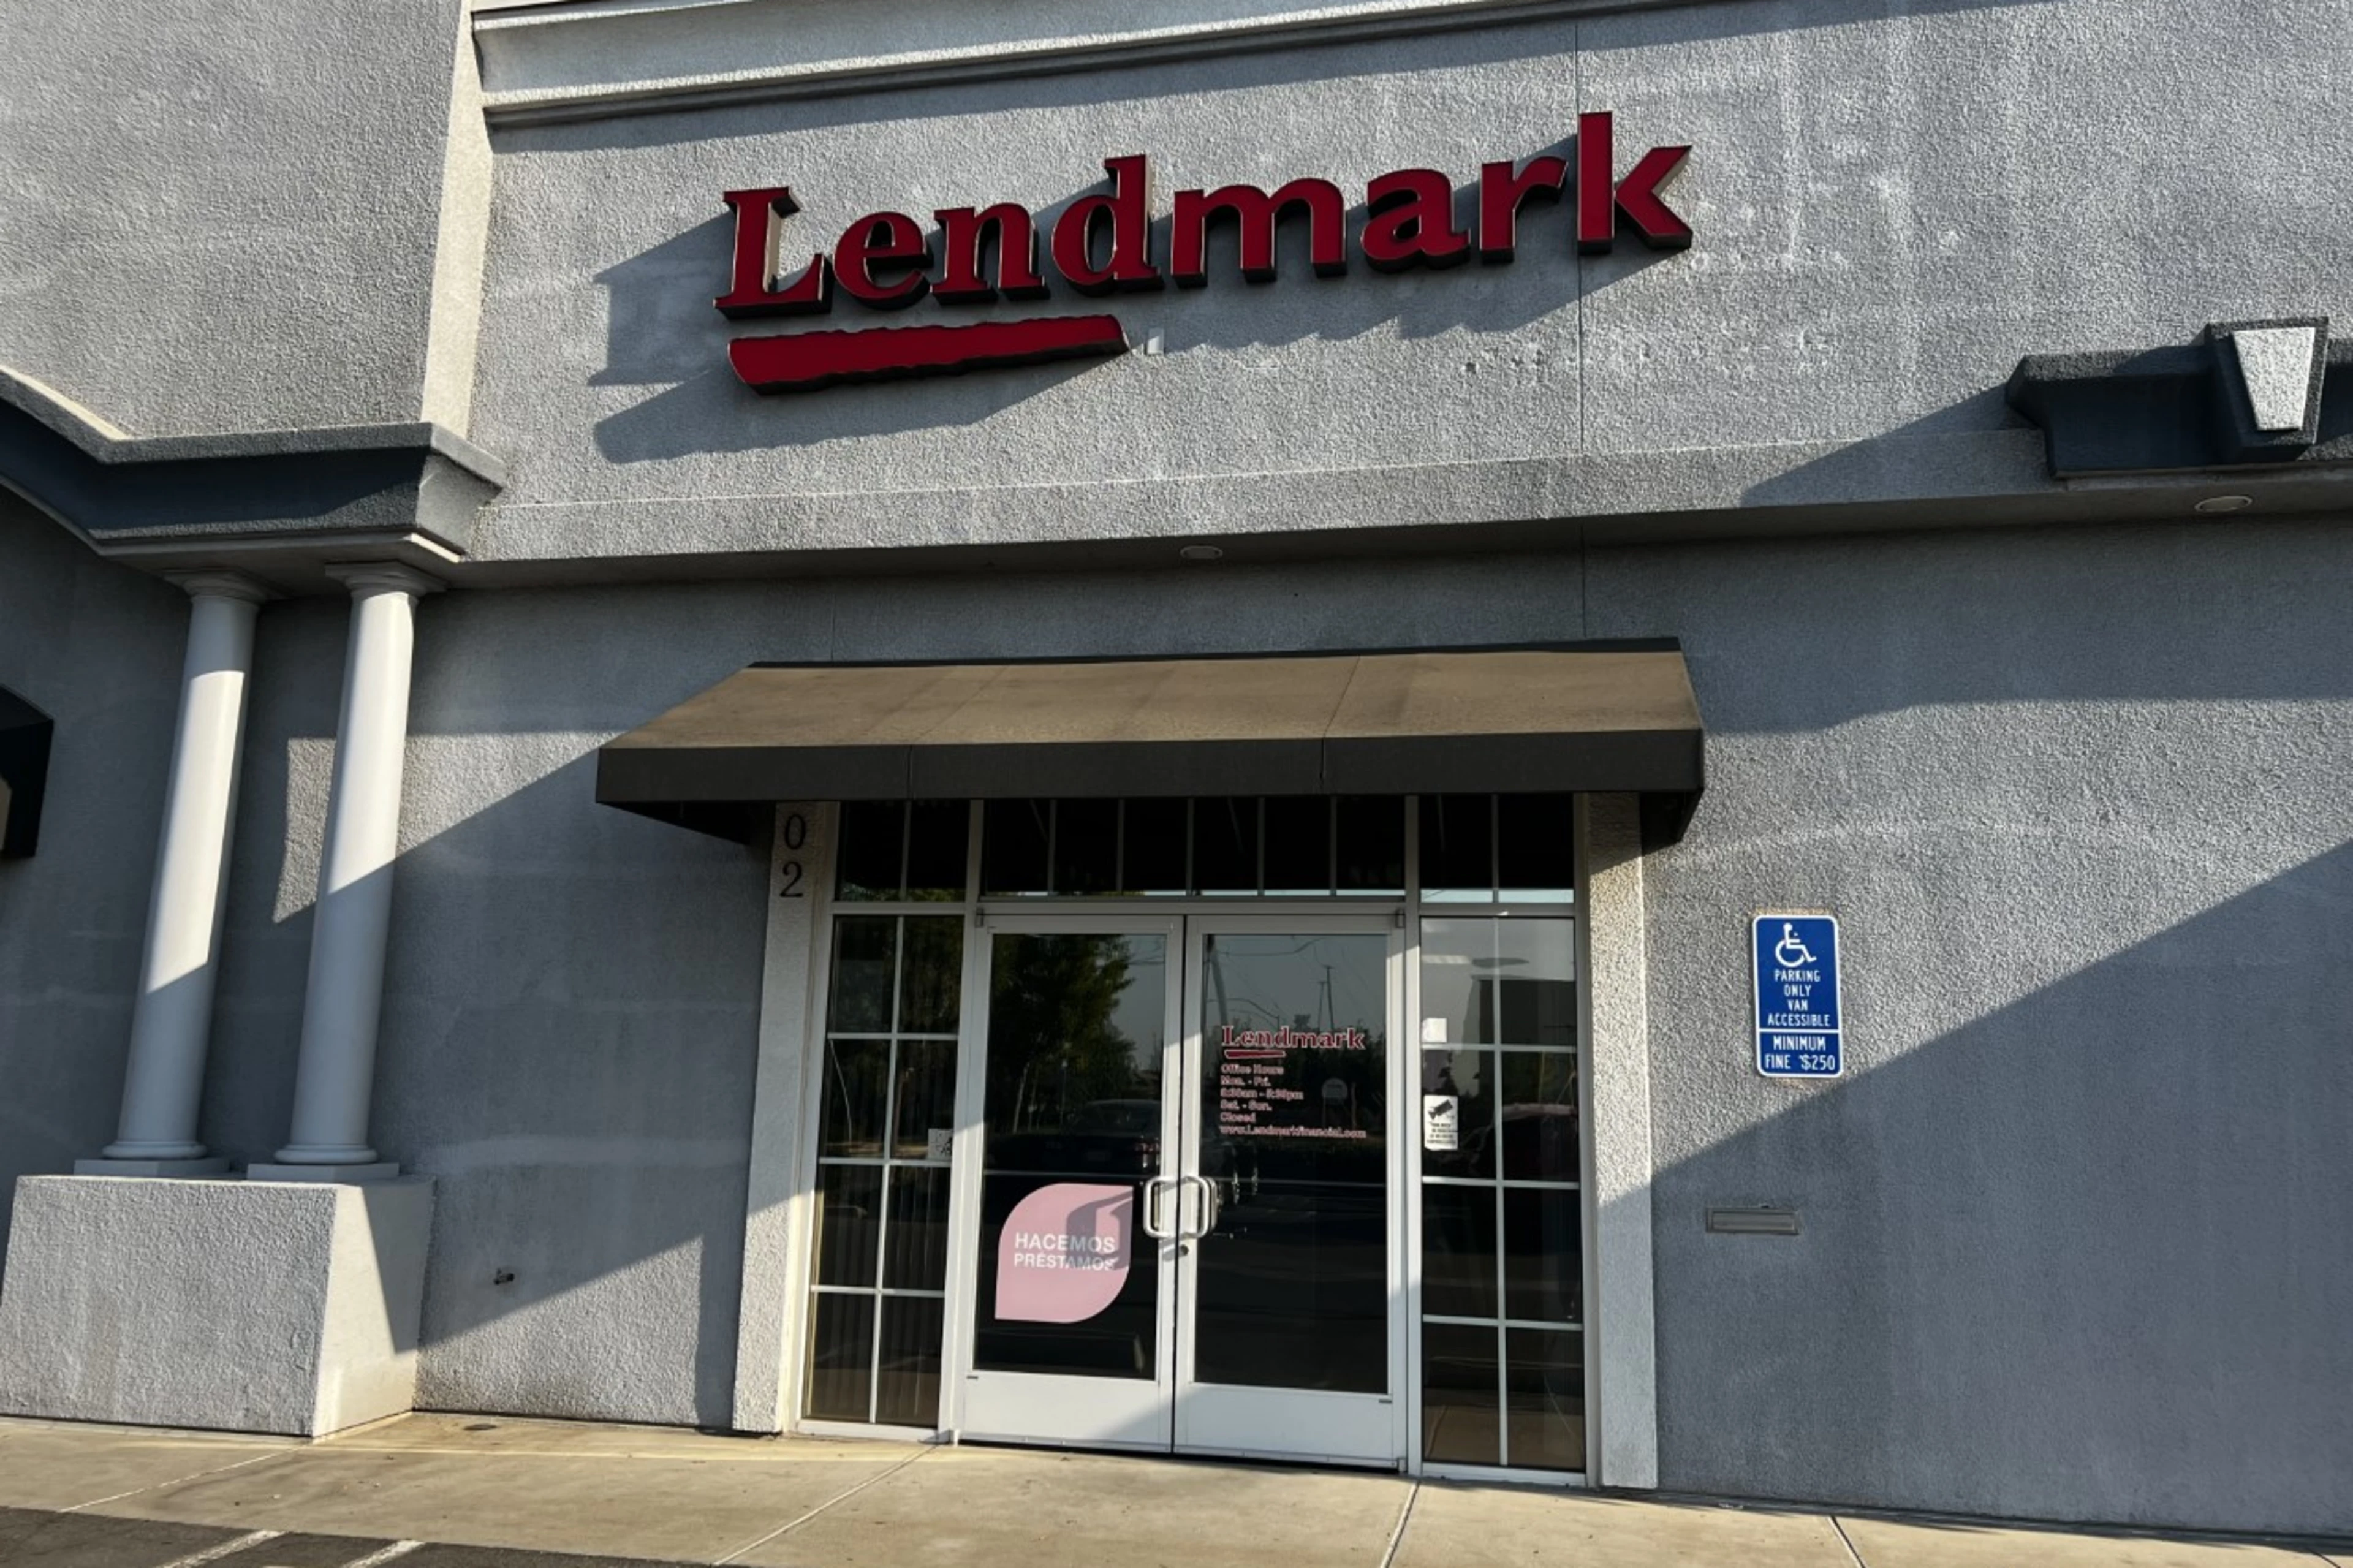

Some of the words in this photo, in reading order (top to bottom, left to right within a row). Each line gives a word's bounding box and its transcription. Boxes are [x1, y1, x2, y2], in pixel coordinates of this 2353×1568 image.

[713, 111, 1693, 314] Lendmark
[1774, 969, 1821, 982] PARKING
[1784, 984, 1812, 997] ONLY
[1787, 999, 1808, 1012] VAN
[1767, 1013, 1830, 1027] ACCESSIBLE
[1221, 1025, 1366, 1050] Lendmark
[1773, 1035, 1826, 1051] MINIMUM
[1220, 1064, 1251, 1074] Office
[1253, 1064, 1284, 1075] Hours
[1765, 1054, 1791, 1069] FINE
[1798, 1053, 1835, 1071] $250
[1220, 1112, 1256, 1123] Closed
[1014, 1232, 1116, 1253] HACEMOS
[1014, 1251, 1116, 1271] PRÉSTAMOS
